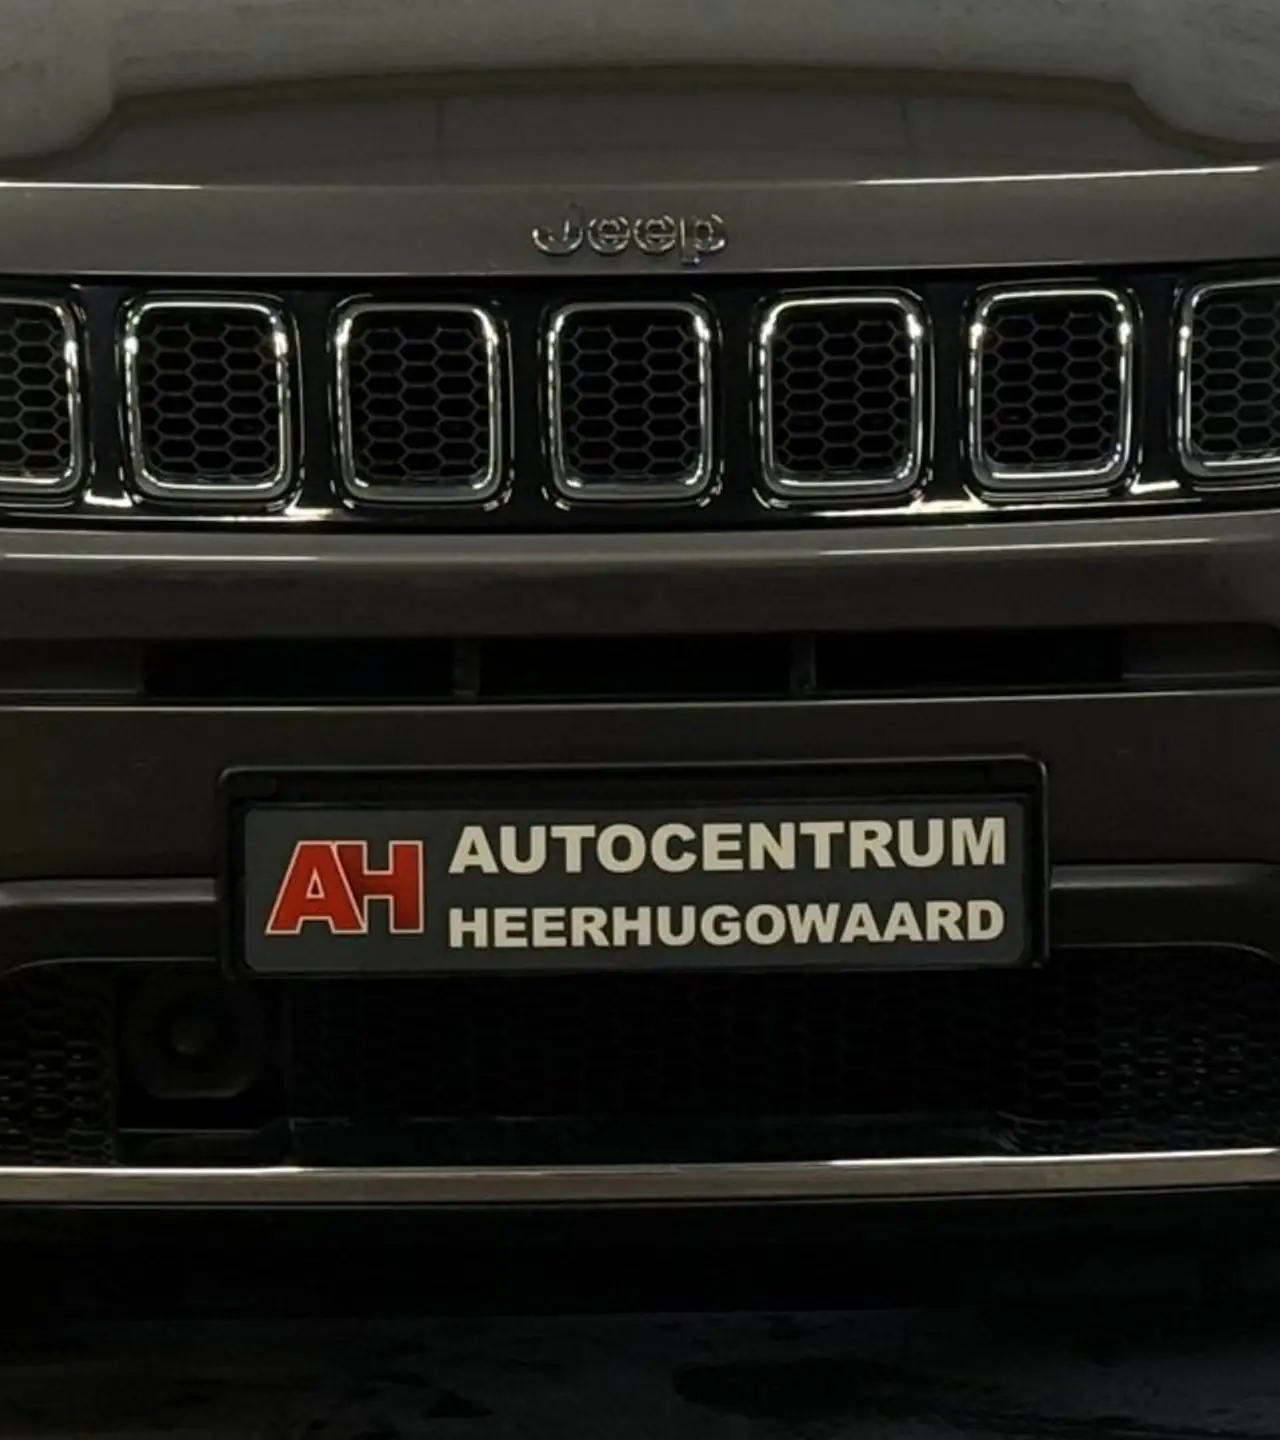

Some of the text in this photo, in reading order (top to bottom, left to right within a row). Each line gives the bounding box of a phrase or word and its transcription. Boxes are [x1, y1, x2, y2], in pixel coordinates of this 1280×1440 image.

[531, 205, 727, 264] Jeep
[448, 817, 1007, 875] AUTOCENTRUM
[264, 840, 425, 936] AH
[448, 900, 1006, 948] HEERHUGOWAARD
